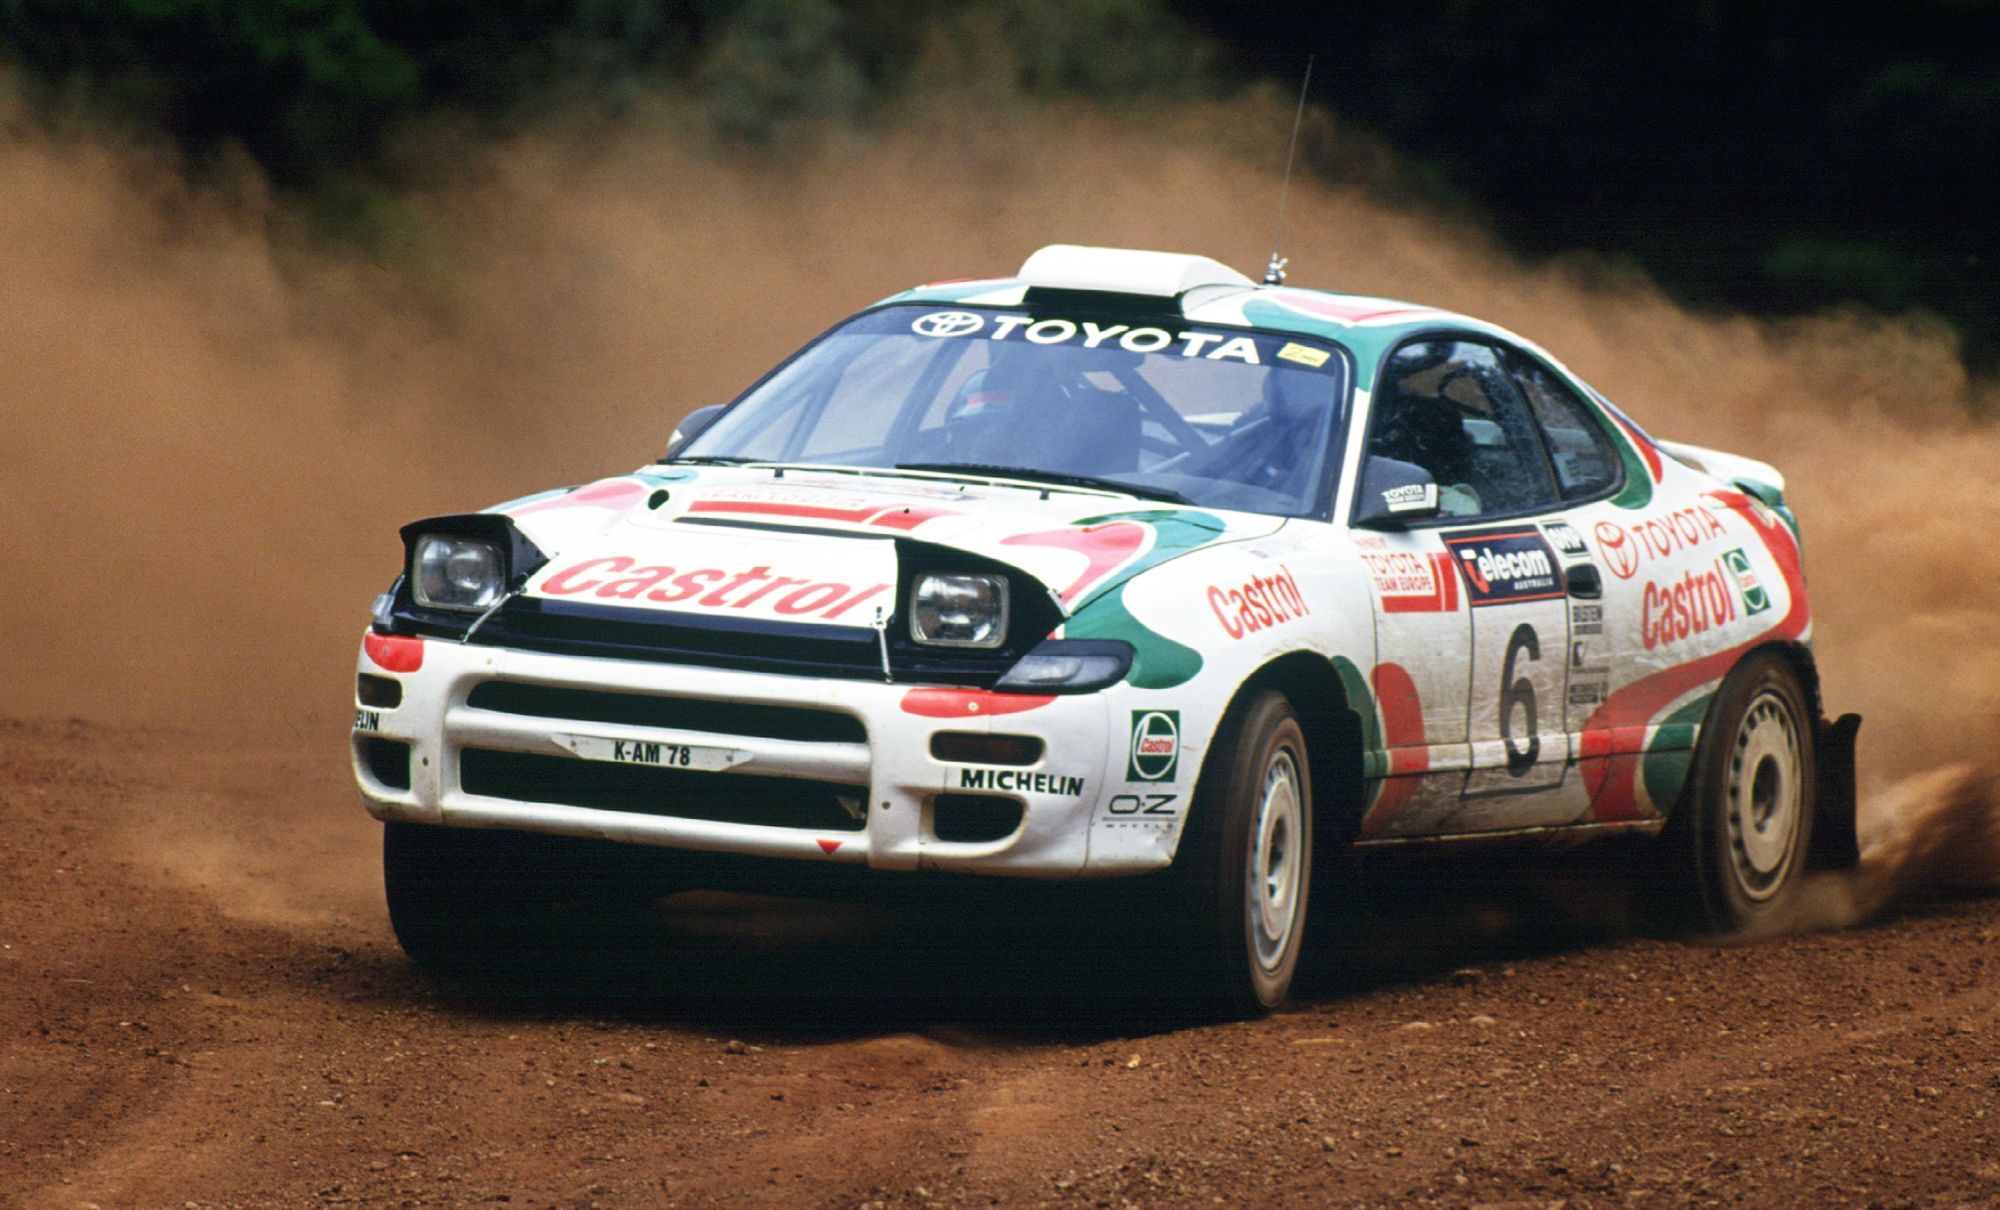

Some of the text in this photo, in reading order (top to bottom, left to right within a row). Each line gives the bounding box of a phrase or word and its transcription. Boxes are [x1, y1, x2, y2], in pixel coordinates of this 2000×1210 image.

[991, 316, 1260, 364] TOYOTA
[1632, 505, 1727, 561] TOYOTA
[541, 556, 892, 619] Castrol
[1360, 552, 1427, 576] TOYOTA
[1460, 547, 1552, 594] Telecom
[1207, 563, 1311, 640] Castrol
[1642, 559, 1735, 650] Castrol
[1499, 623, 1541, 778] 6
[614, 741, 691, 766] K-AM 78
[960, 768, 1085, 796] MICHELIN
